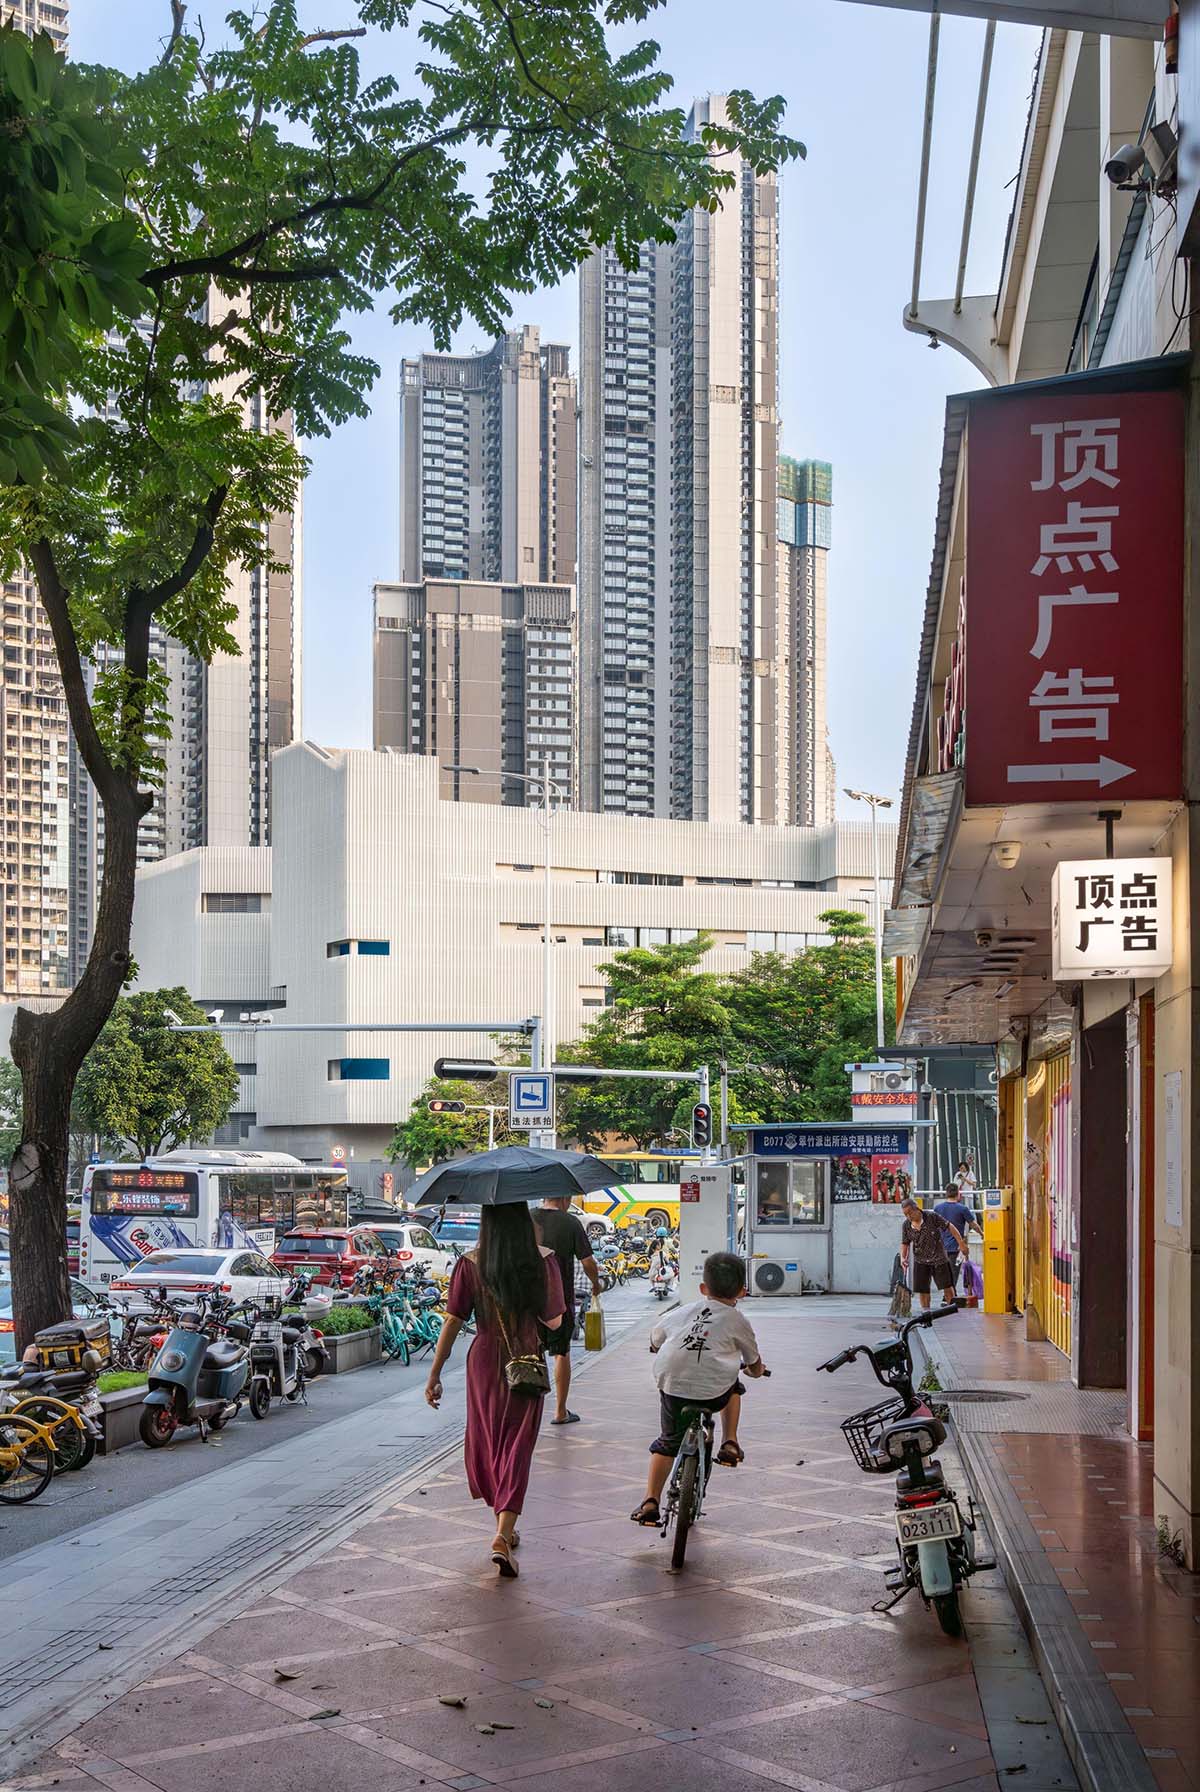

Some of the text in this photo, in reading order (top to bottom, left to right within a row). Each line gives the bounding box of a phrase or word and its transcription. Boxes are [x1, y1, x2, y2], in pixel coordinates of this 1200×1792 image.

[1029, 418, 1121, 742] 顶点广告
[1074, 873, 1158, 909] 顶点
[1074, 915, 1158, 953] 广告
[512, 1116, 552, 1126] 违法抓拍
[902, 1518, 953, 1538] 023111
